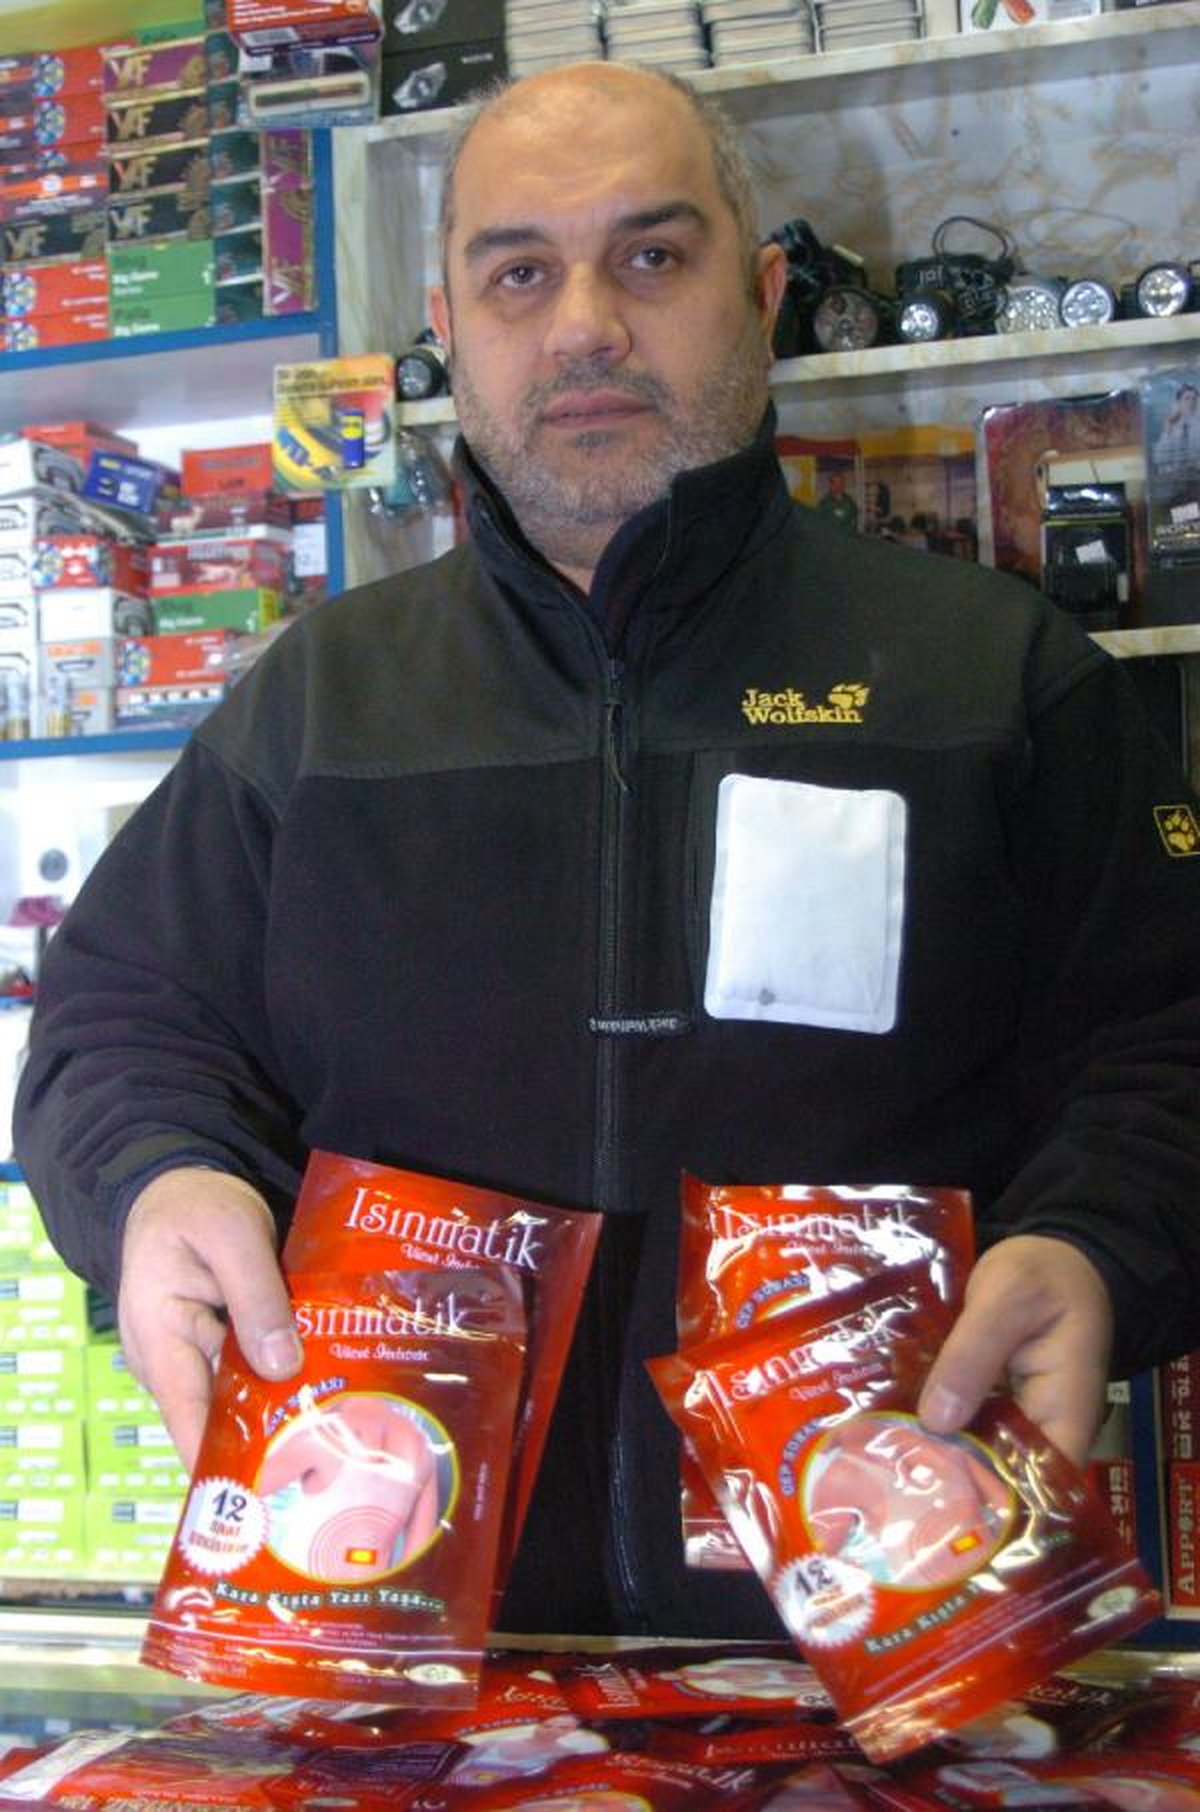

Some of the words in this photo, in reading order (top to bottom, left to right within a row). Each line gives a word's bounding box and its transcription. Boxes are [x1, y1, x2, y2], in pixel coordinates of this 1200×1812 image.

[742, 688, 803, 707] Jack
[742, 704, 863, 724] Wolfskin
[295, 1291, 466, 1337] sınmatik
[211, 1488, 247, 1522] 12
